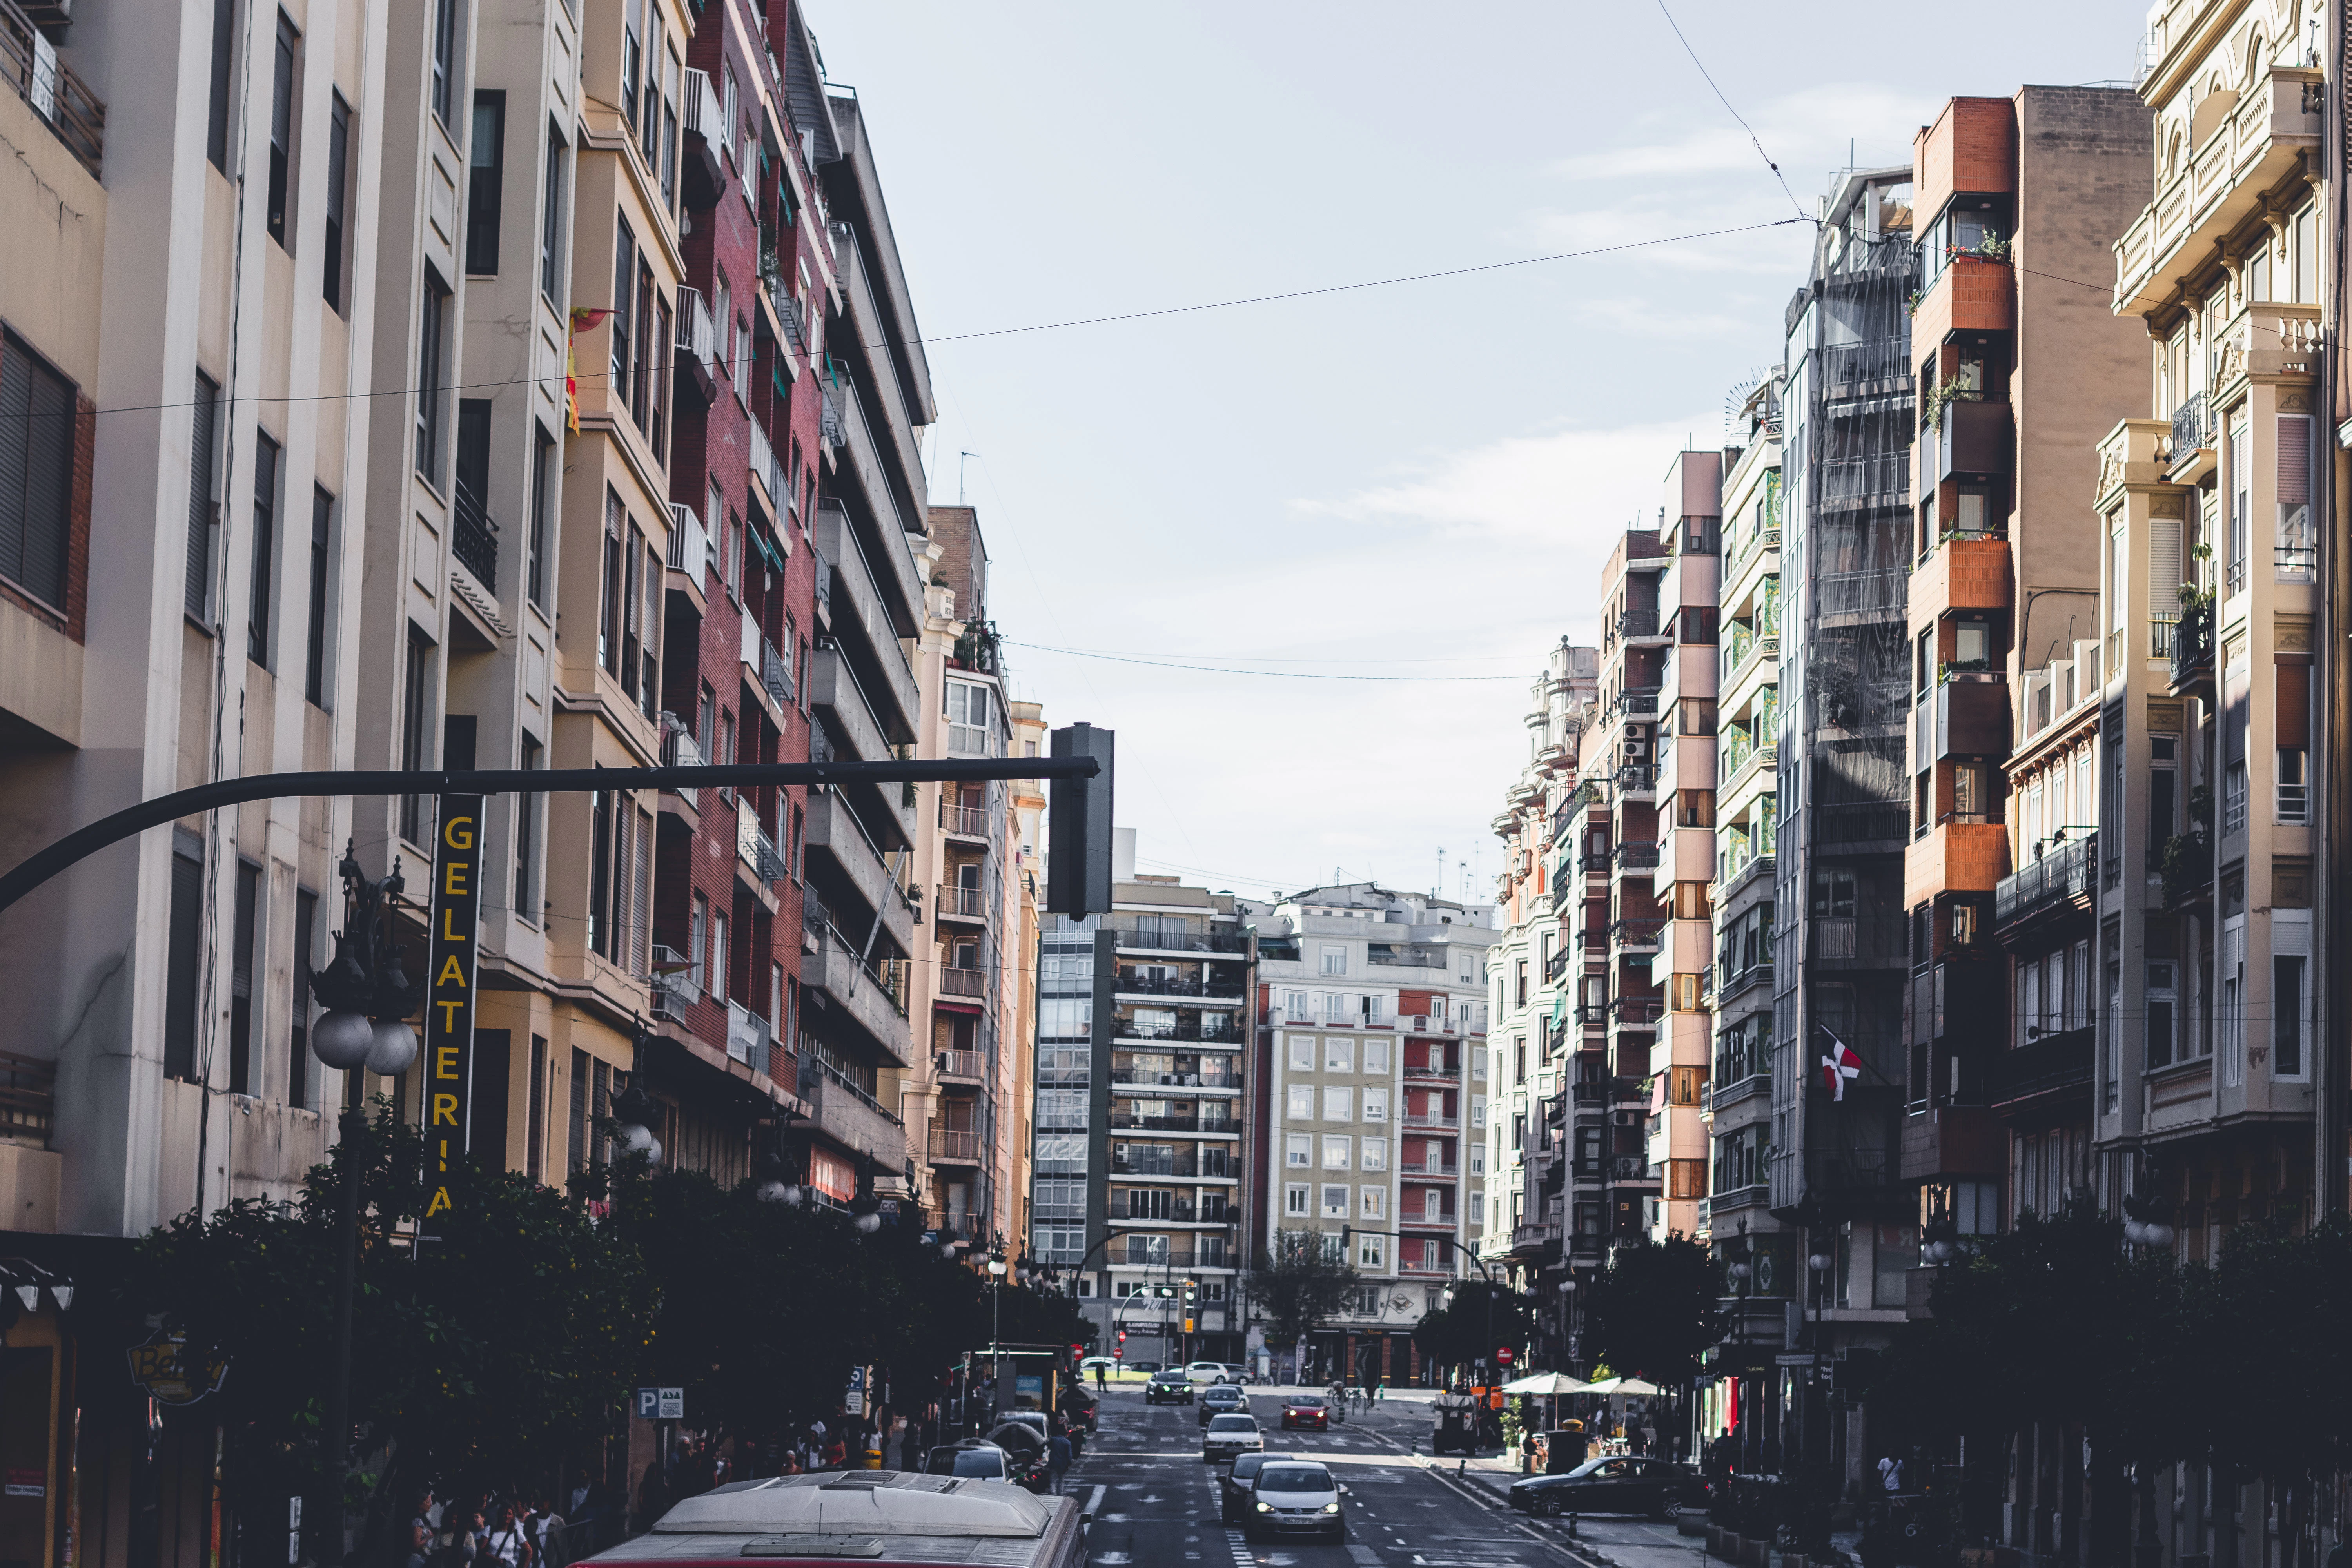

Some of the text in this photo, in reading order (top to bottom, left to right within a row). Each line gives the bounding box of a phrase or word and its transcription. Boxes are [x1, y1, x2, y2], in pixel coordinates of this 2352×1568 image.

[426, 816, 473, 1218] GELATERIA
[1696, 1377, 1703, 1387] P
[641, 1392, 657, 1415] P
